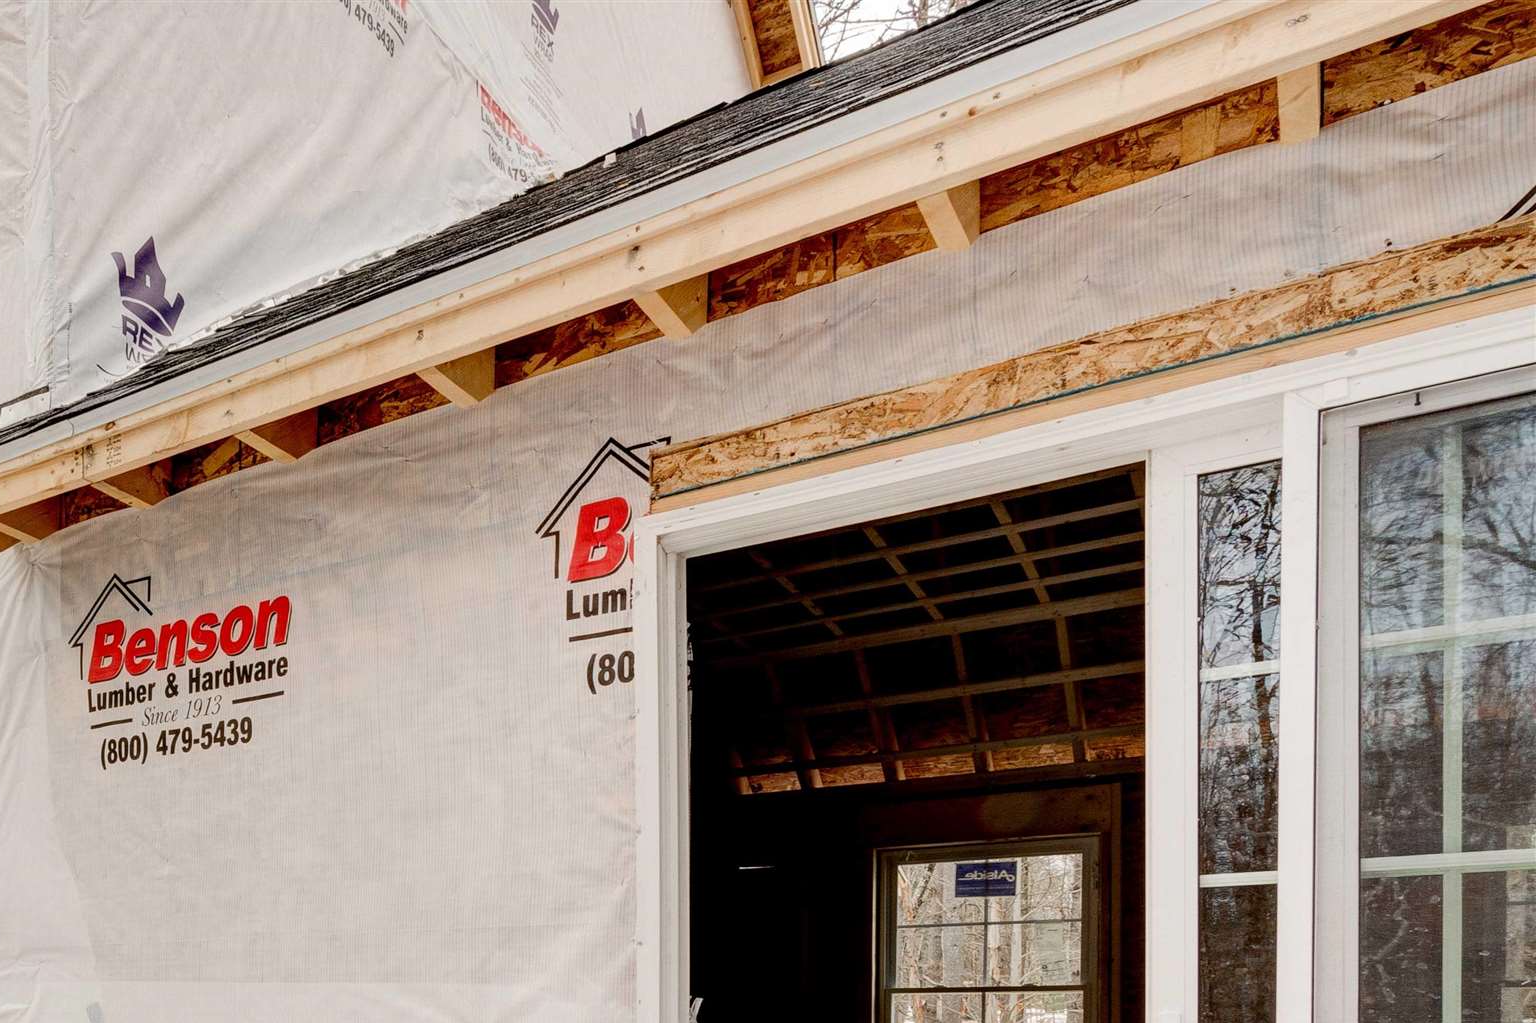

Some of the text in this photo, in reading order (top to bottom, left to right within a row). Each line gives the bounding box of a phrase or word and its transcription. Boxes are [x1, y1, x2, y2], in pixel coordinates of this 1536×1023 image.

[355, 4, 395, 57] 479-5439
[87, 594, 293, 684] Benson
[88, 656, 289, 713] Lumber & Hardware
[587, 650, 635, 694] (80
[141, 694, 222, 727] Since 1913
[100, 716, 253, 770] (800) 479-5439
